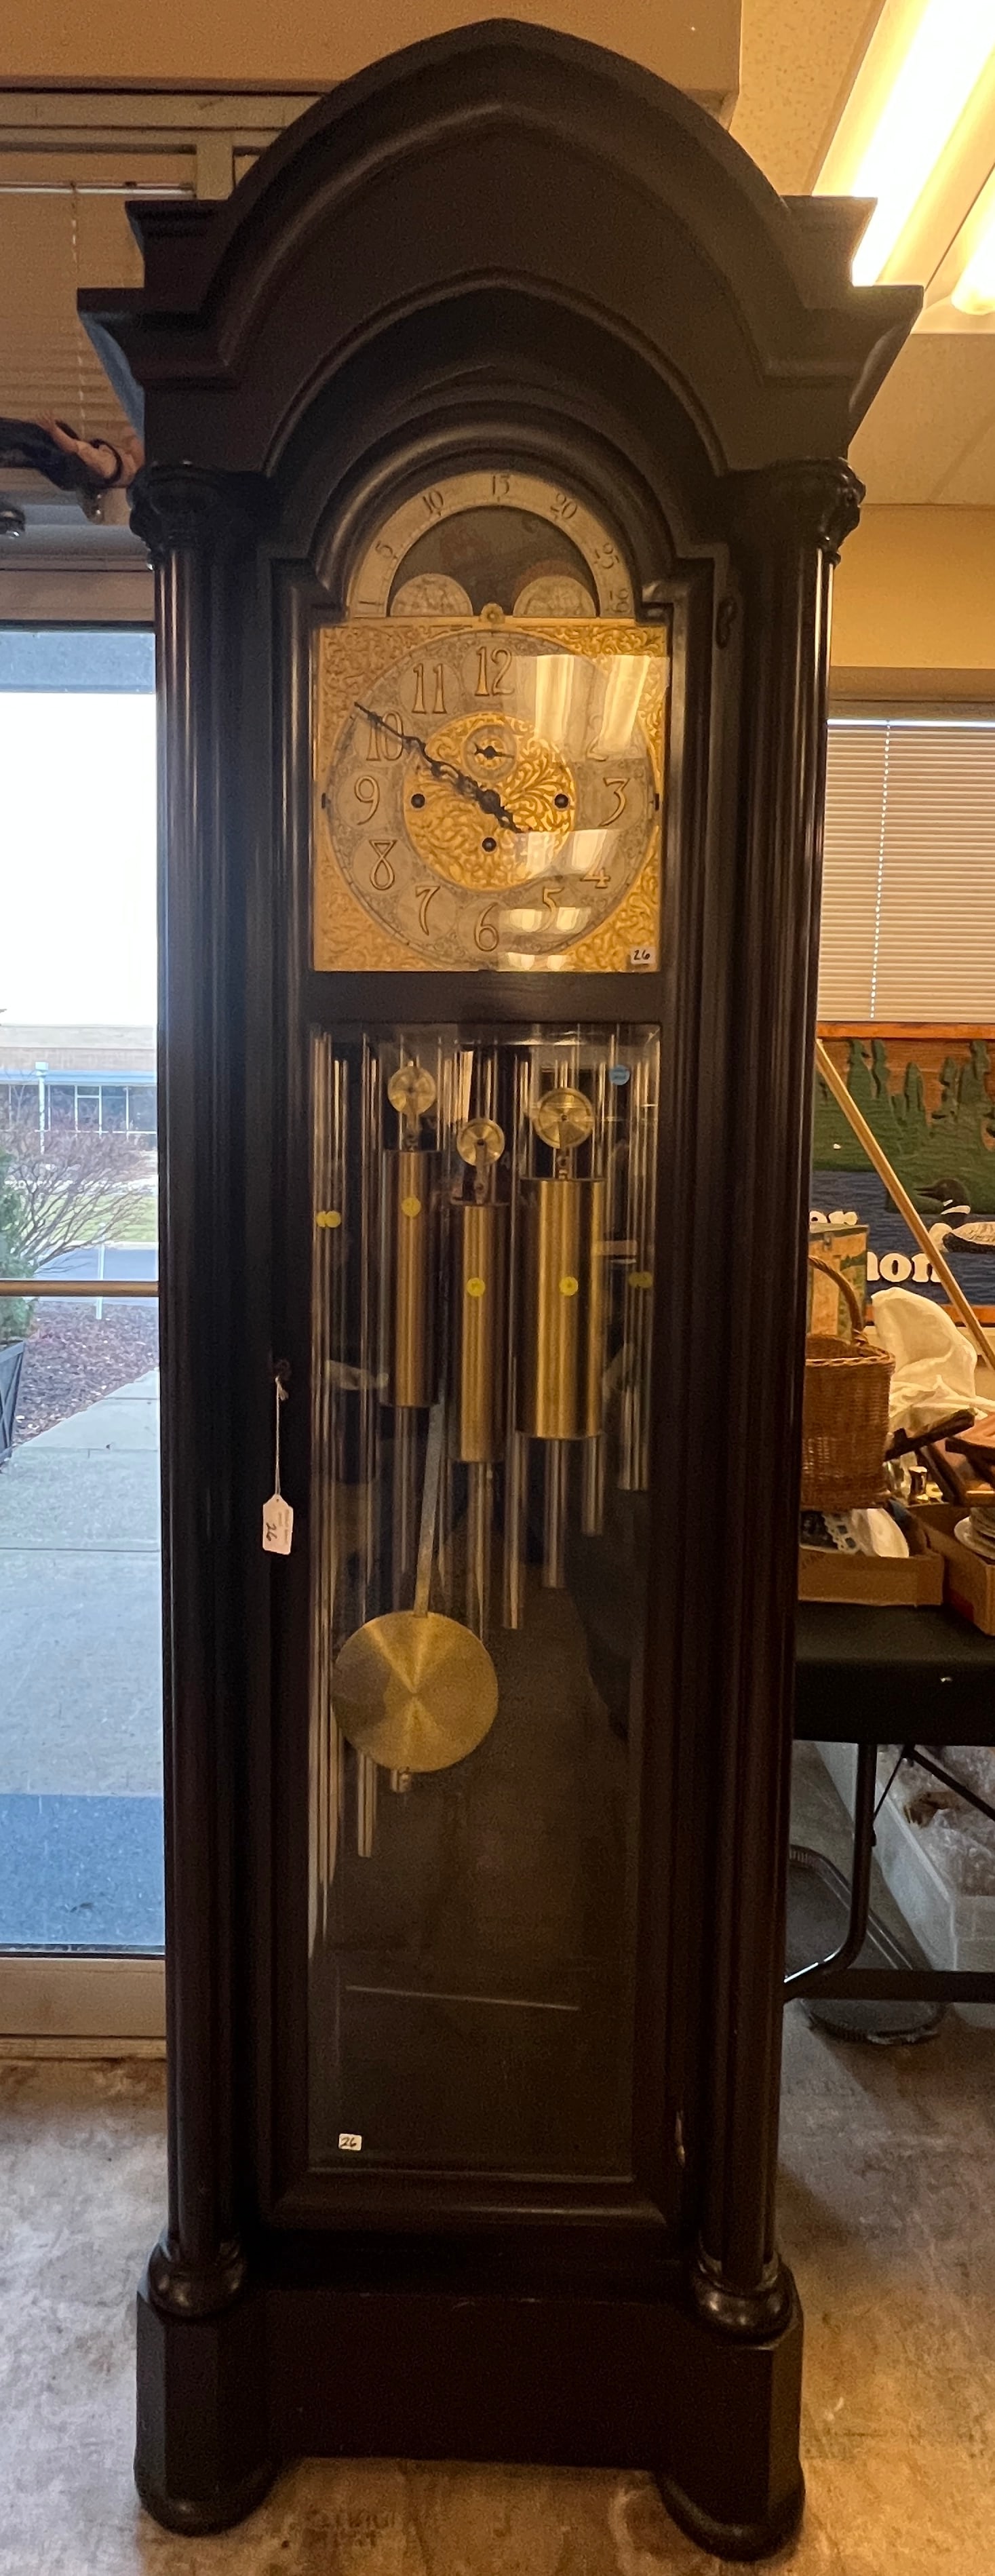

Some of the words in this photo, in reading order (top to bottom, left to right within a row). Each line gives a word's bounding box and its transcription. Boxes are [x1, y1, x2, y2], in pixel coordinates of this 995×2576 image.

[422, 489, 444, 514] 10
[492, 475, 509, 495] 15
[551, 493, 578, 520] 20
[375, 543, 393, 559] 5
[411, 663, 448, 714] 11
[474, 646, 515, 697] 12
[366, 711, 404, 762] 10
[354, 775, 381, 826] 9
[599, 777, 631, 827] 3
[368, 839, 398, 891] 8
[579, 838, 611, 889] 4
[415, 885, 441, 936] 7
[474, 901, 500, 952] 6
[540, 886, 565, 933] 5
[633, 949, 650, 960] 26
[265, 1521, 278, 1542] 26
[340, 2136, 357, 2148] 26
